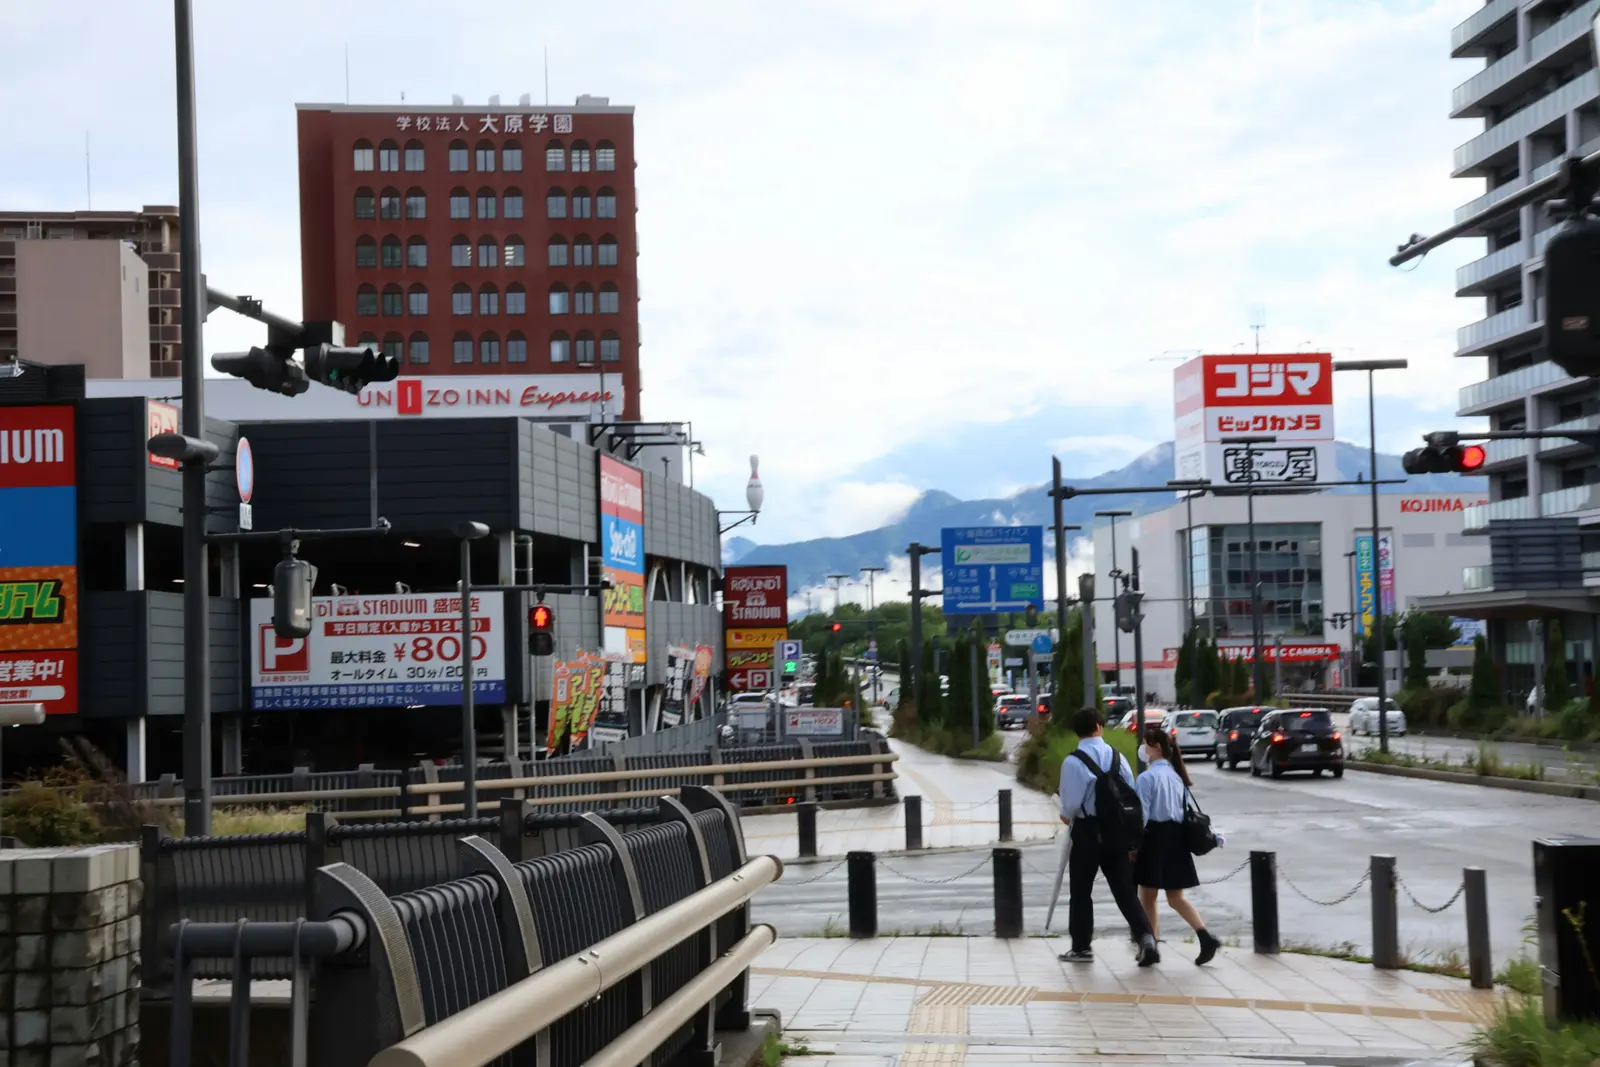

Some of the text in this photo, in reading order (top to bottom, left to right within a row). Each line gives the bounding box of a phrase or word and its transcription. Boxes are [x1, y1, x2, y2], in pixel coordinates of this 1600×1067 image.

[1215, 362, 1321, 397] コジマ
[467, 389, 511, 405] INN
[1217, 414, 1321, 432] ビックカメラ
[1400, 498, 1464, 512] KOJIMA
[731, 576, 781, 591] ROUND1
[363, 598, 428, 616] STADIUM
[732, 606, 782, 620] STADIUM
[331, 650, 387, 665] 最大料金
[331, 667, 398, 681] オールタイム
